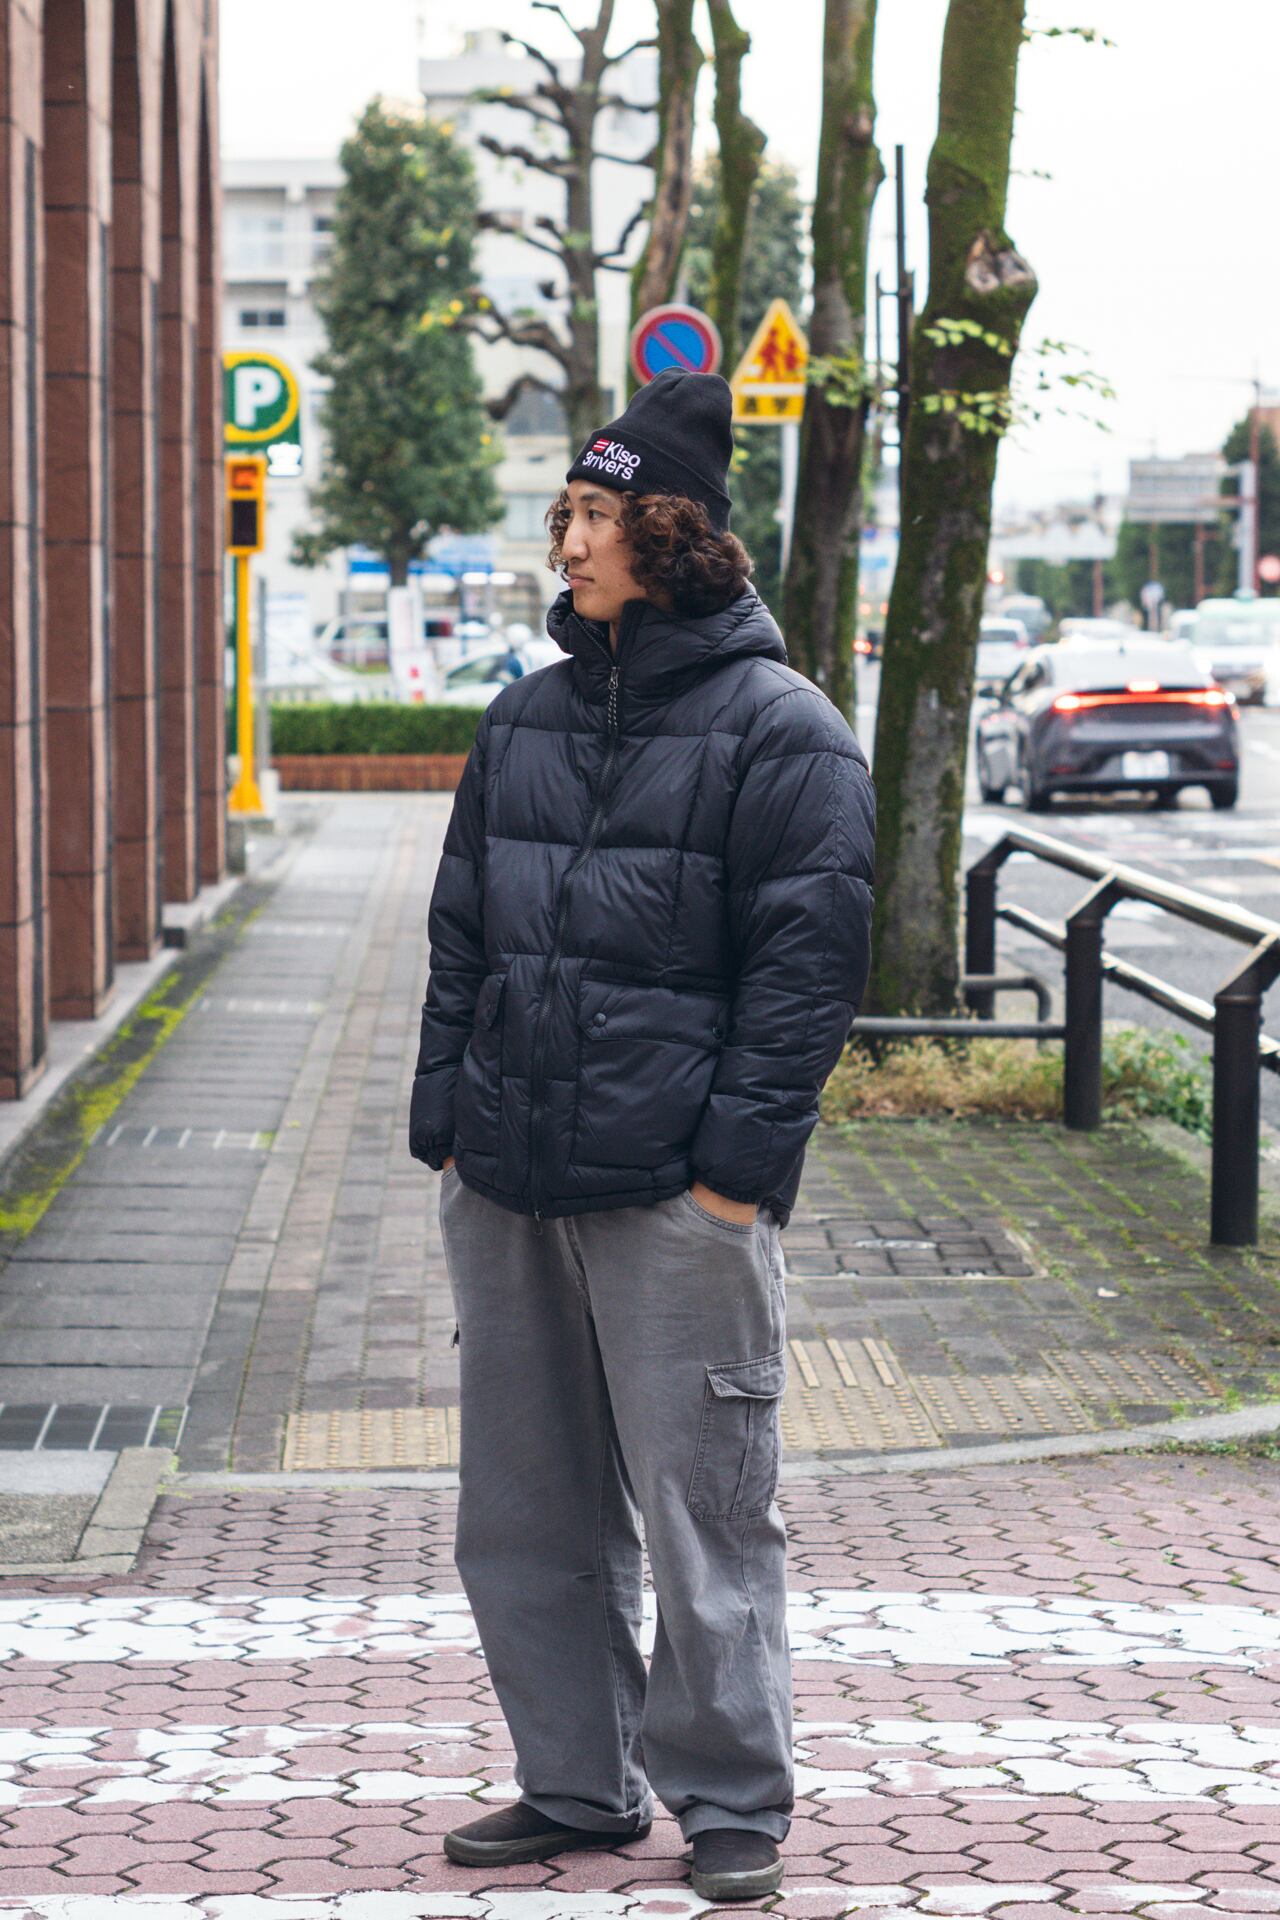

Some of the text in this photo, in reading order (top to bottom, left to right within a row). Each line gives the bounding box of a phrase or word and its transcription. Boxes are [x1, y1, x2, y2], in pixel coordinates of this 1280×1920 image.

[234, 366, 281, 426] P
[582, 451, 634, 480] 3rivers
[604, 441, 641, 468] Kiso
